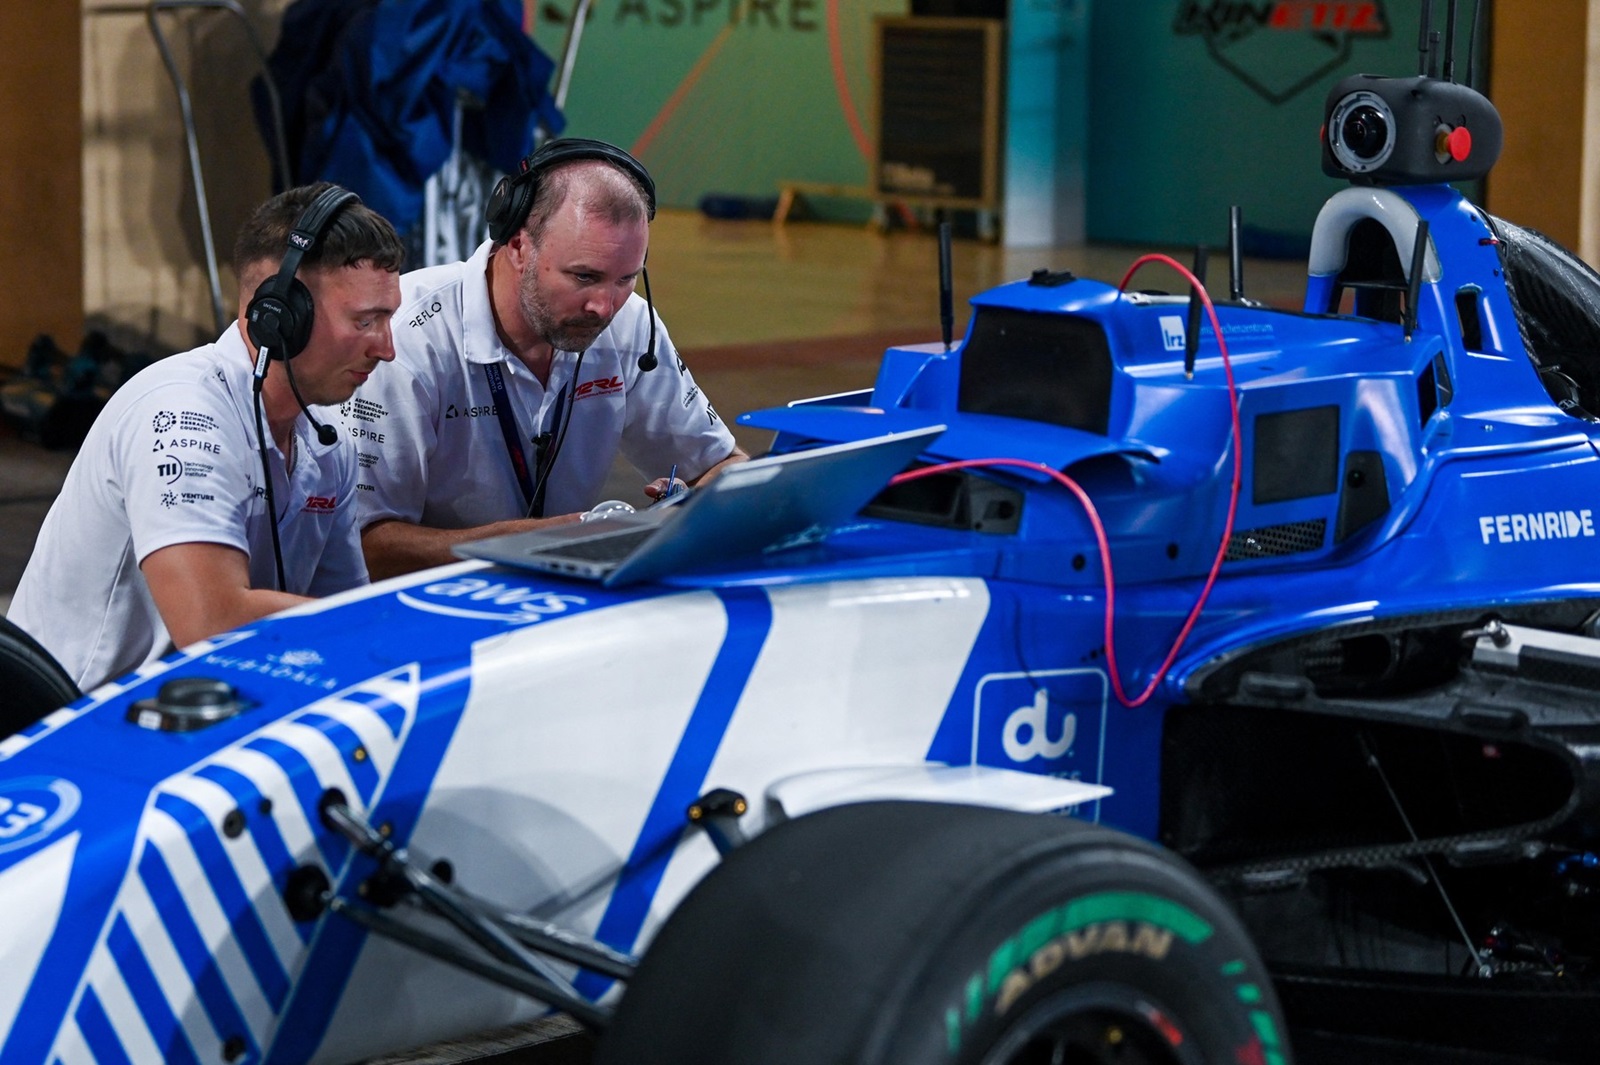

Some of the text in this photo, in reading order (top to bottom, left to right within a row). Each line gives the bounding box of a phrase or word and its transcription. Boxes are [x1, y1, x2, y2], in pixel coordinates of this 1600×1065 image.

[409, 301, 442, 328] REFLO
[496, 381, 503, 390] TO
[354, 403, 389, 416] TECHNOLOGY
[355, 398, 383, 409] ADVANCED
[181, 411, 214, 422] ADVANCED
[352, 413, 375, 423] COUNCIL
[353, 408, 381, 419] RESEARCH
[180, 416, 219, 429] TECHNOLOGY
[180, 421, 213, 430] RESEARCH
[349, 427, 385, 443] SPIRE
[170, 439, 221, 454] ASPIRE
[157, 463, 177, 477] TII
[184, 461, 214, 470] Technology
[181, 493, 215, 501] VENTURE
[1479, 509, 1595, 545] FERNRIDE
[424, 578, 588, 614] aws
[1002, 687, 1077, 763] du
[0, 796, 47, 839] 3
[995, 920, 1176, 1017] ADVAN
